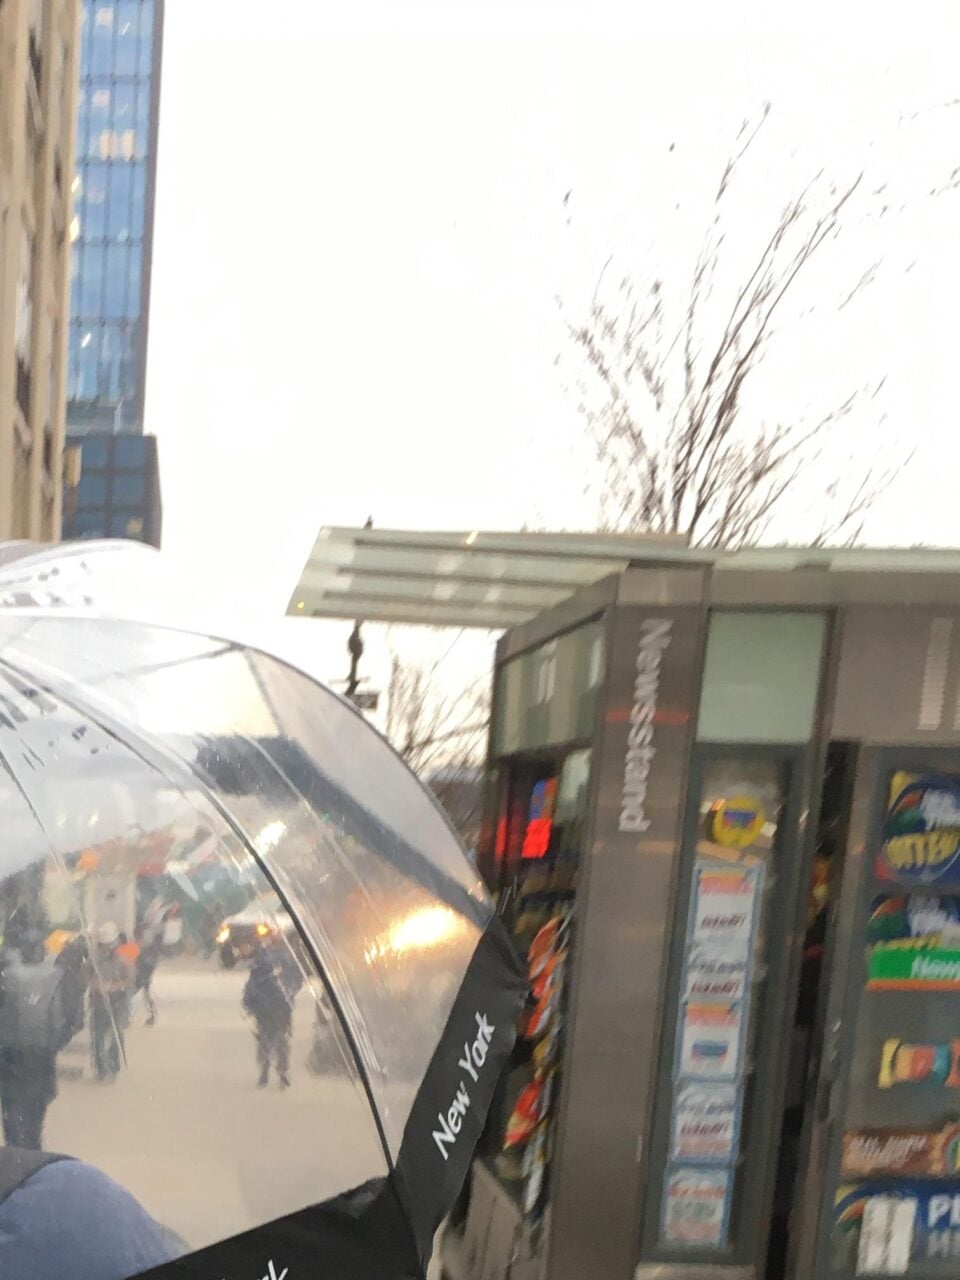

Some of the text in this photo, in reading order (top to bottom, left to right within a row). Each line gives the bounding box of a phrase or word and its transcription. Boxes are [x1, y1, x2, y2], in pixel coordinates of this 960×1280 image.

[618, 618, 674, 832] Newsstand
[431, 1010, 496, 1161] New York
